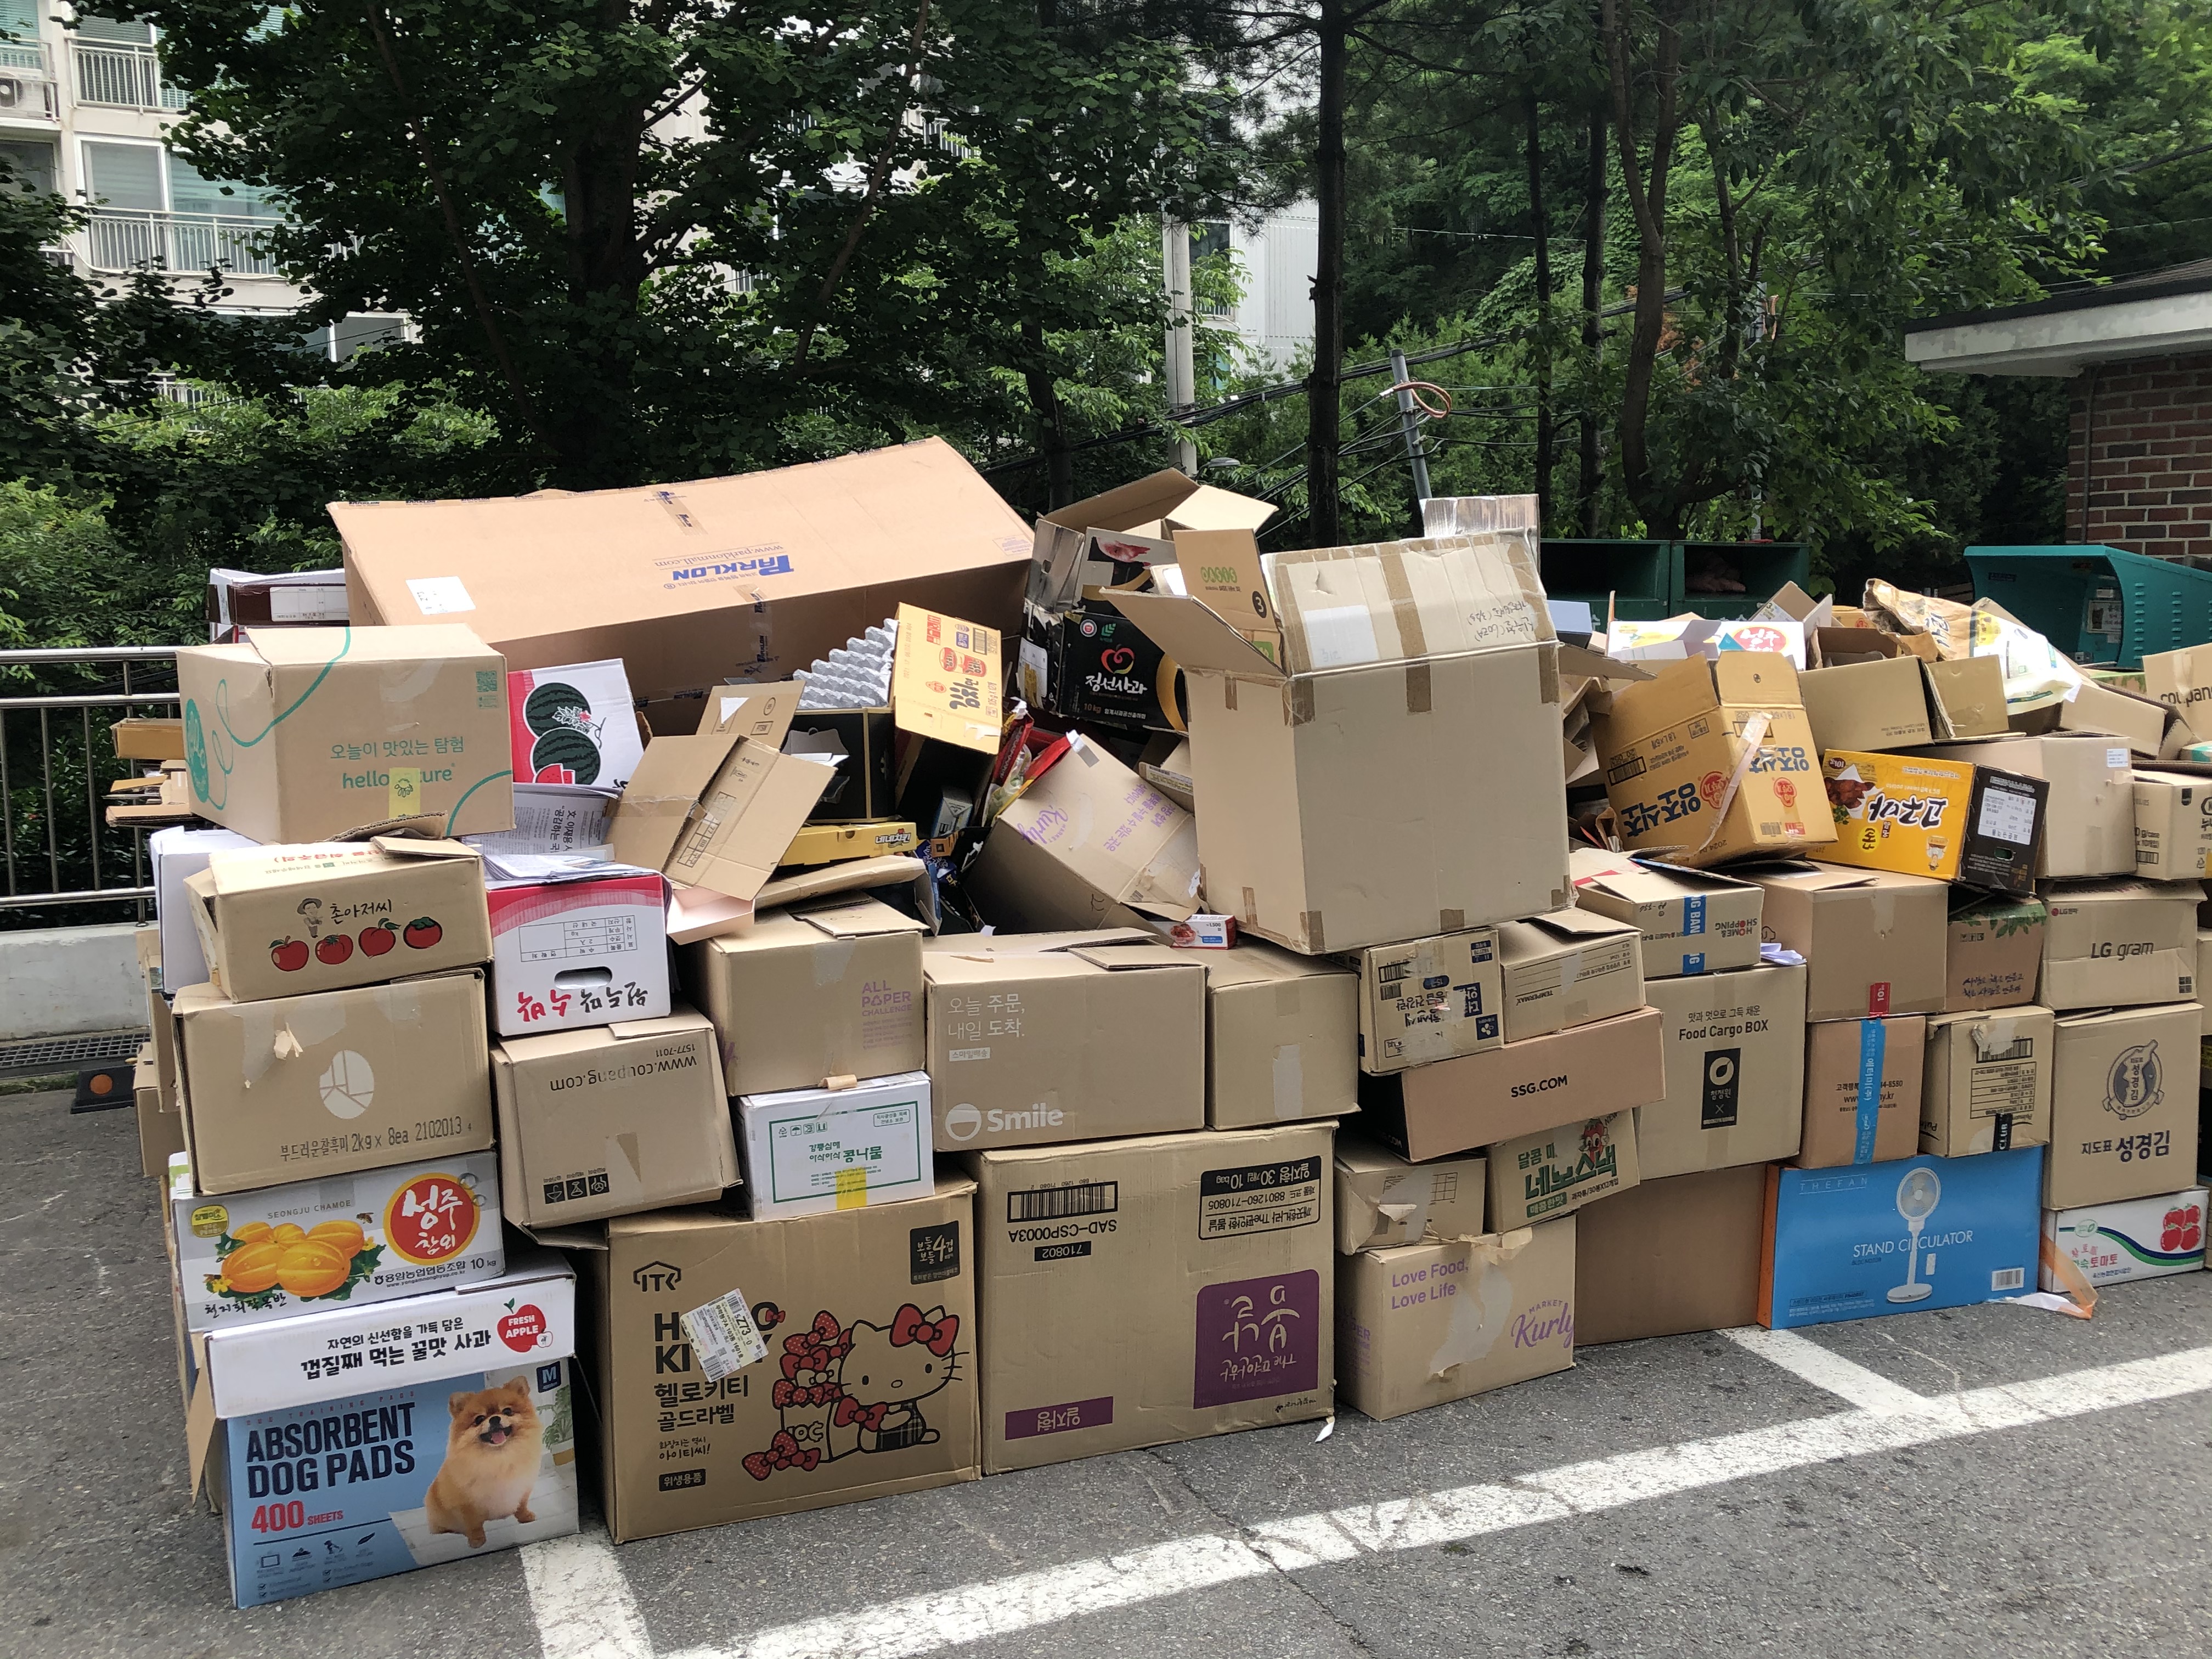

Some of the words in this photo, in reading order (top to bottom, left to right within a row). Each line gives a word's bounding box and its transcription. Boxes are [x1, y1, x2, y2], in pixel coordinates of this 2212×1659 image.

[654, 544, 784, 567] www.parklonmall.com
[672, 554, 795, 581] PARKLON
[1255, 596, 1265, 613] 3
[1085, 672, 1148, 695] 정선사과
[1084, 703, 1092, 711] 10
[330, 741, 377, 760] 오늘이
[383, 739, 430, 757] 맛있는
[434, 736, 464, 754] 탐험
[1621, 782, 1701, 838] 양조식초
[1866, 793, 1949, 831] 고구마
[563, 821, 575, 844] 이재용
[1017, 804, 1068, 846] Kurly
[1115, 824, 1132, 838] 있는
[1127, 819, 1137, 827] 수
[1103, 836, 1121, 851] 곳은
[329, 898, 392, 924] 촌아저씨
[1720, 927, 1753, 938] HOME&
[2090, 942, 2112, 959] LG
[2117, 942, 2154, 961] gram
[579, 981, 648, 1013] 원두막
[862, 980, 891, 994] ALL
[1516, 990, 1554, 1006] TEMPERMAX
[516, 989, 572, 1023] 수박
[861, 991, 911, 1008] PAPER
[862, 1004, 912, 1017] CHALLENGE
[947, 996, 982, 1016] 오늘
[987, 993, 1025, 1014] 주문,
[1688, 1011, 1703, 1023] 맛과
[1705, 1009, 1727, 1021] 멋으로
[1729, 1007, 1744, 1018] 그득
[1745, 1005, 1760, 1017] 채운
[947, 1020, 981, 1041] 내일
[987, 1018, 1025, 1038] 도착.
[1679, 1026, 1707, 1041] Food
[1709, 1025, 1743, 1038] Cargo
[1745, 1019, 1769, 1033] BOX
[655, 1043, 696, 1058] 1577-7011
[952, 1049, 988, 1059] 스마일배송
[1511, 1074, 1568, 1098] SSG.COM
[1710, 1088, 1731, 1101] 청정원
[987, 1102, 1064, 1132] Smile
[280, 1135, 349, 1162] 부드러운찰흑미
[351, 1133, 373, 1153] 2kg
[387, 1127, 409, 1147] 8ea
[415, 1115, 462, 1142] 2102013
[1999, 1123, 2008, 1150] CLUB
[2081, 1139, 2113, 1155] 지도표
[2115, 1130, 2170, 1163] 성경김
[843, 1146, 883, 1163] 콩나물
[1517, 1148, 1542, 1170] 달콤
[1279, 1163, 1310, 1183] 일자형
[1208, 1191, 1286, 1210] 8801260-710805
[1289, 1188, 1301, 1198] 코드
[1304, 1185, 1316, 1197] 제품
[267, 1206, 311, 1219] SEONGJU
[314, 1199, 351, 1212] CHAMOE
[402, 1184, 464, 1231] 성주
[1272, 1206, 1312, 1224] 깨끗한나라
[1530, 1194, 1564, 1214] 매콤한맛
[1007, 1218, 1118, 1244] SAD-CSP0003A
[1208, 1217, 1227, 1233] 봄날
[414, 1232, 456, 1255] 참외
[917, 1236, 933, 1252] 보들
[1042, 1244, 1084, 1259] 710802
[1853, 1240, 1894, 1257] STAND
[1898, 1230, 1973, 1252] CICULATOR
[919, 1251, 936, 1265] 보들
[385, 1262, 466, 1284] 용암농업협동조합
[471, 1257, 484, 1270] 10
[487, 1257, 497, 1268] kg
[1392, 1269, 1427, 1288] Love
[1391, 1291, 1426, 1310] Love
[1430, 1282, 1457, 1300] Life
[1528, 1299, 1563, 1315] MARKET
[507, 1314, 535, 1327] FRESH
[1222, 1284, 1300, 1353] 봄날
[1510, 1302, 1574, 1348] Kurly
[327, 1334, 364, 1350] 자연의
[367, 1325, 413, 1347] 신선함을
[416, 1321, 438, 1335] 가득
[441, 1316, 464, 1330] 담은
[505, 1324, 539, 1339] APPLE
[300, 1351, 363, 1380] 껍질째
[369, 1345, 405, 1367] 먹는
[411, 1336, 447, 1359] 꿀맛
[454, 1329, 492, 1351] 사과
[1273, 1353, 1296, 1369] The
[541, 1366, 557, 1384] M
[1220, 1354, 1271, 1383] 편안한
[653, 1374, 749, 1408] 헬로키티
[657, 1403, 735, 1433] 골드라벨
[1037, 1406, 1081, 1432] 일자형
[246, 1401, 416, 1464] ABSORBENT
[658, 1438, 690, 1449] 화장지는
[691, 1436, 706, 1446] 역시
[658, 1443, 711, 1461] 아이티씨!
[246, 1457, 319, 1499] DOG
[326, 1439, 416, 1488] PADS
[663, 1472, 702, 1487] 위생용품
[251, 1500, 304, 1534] 400
[307, 1510, 344, 1526] SHEETS
